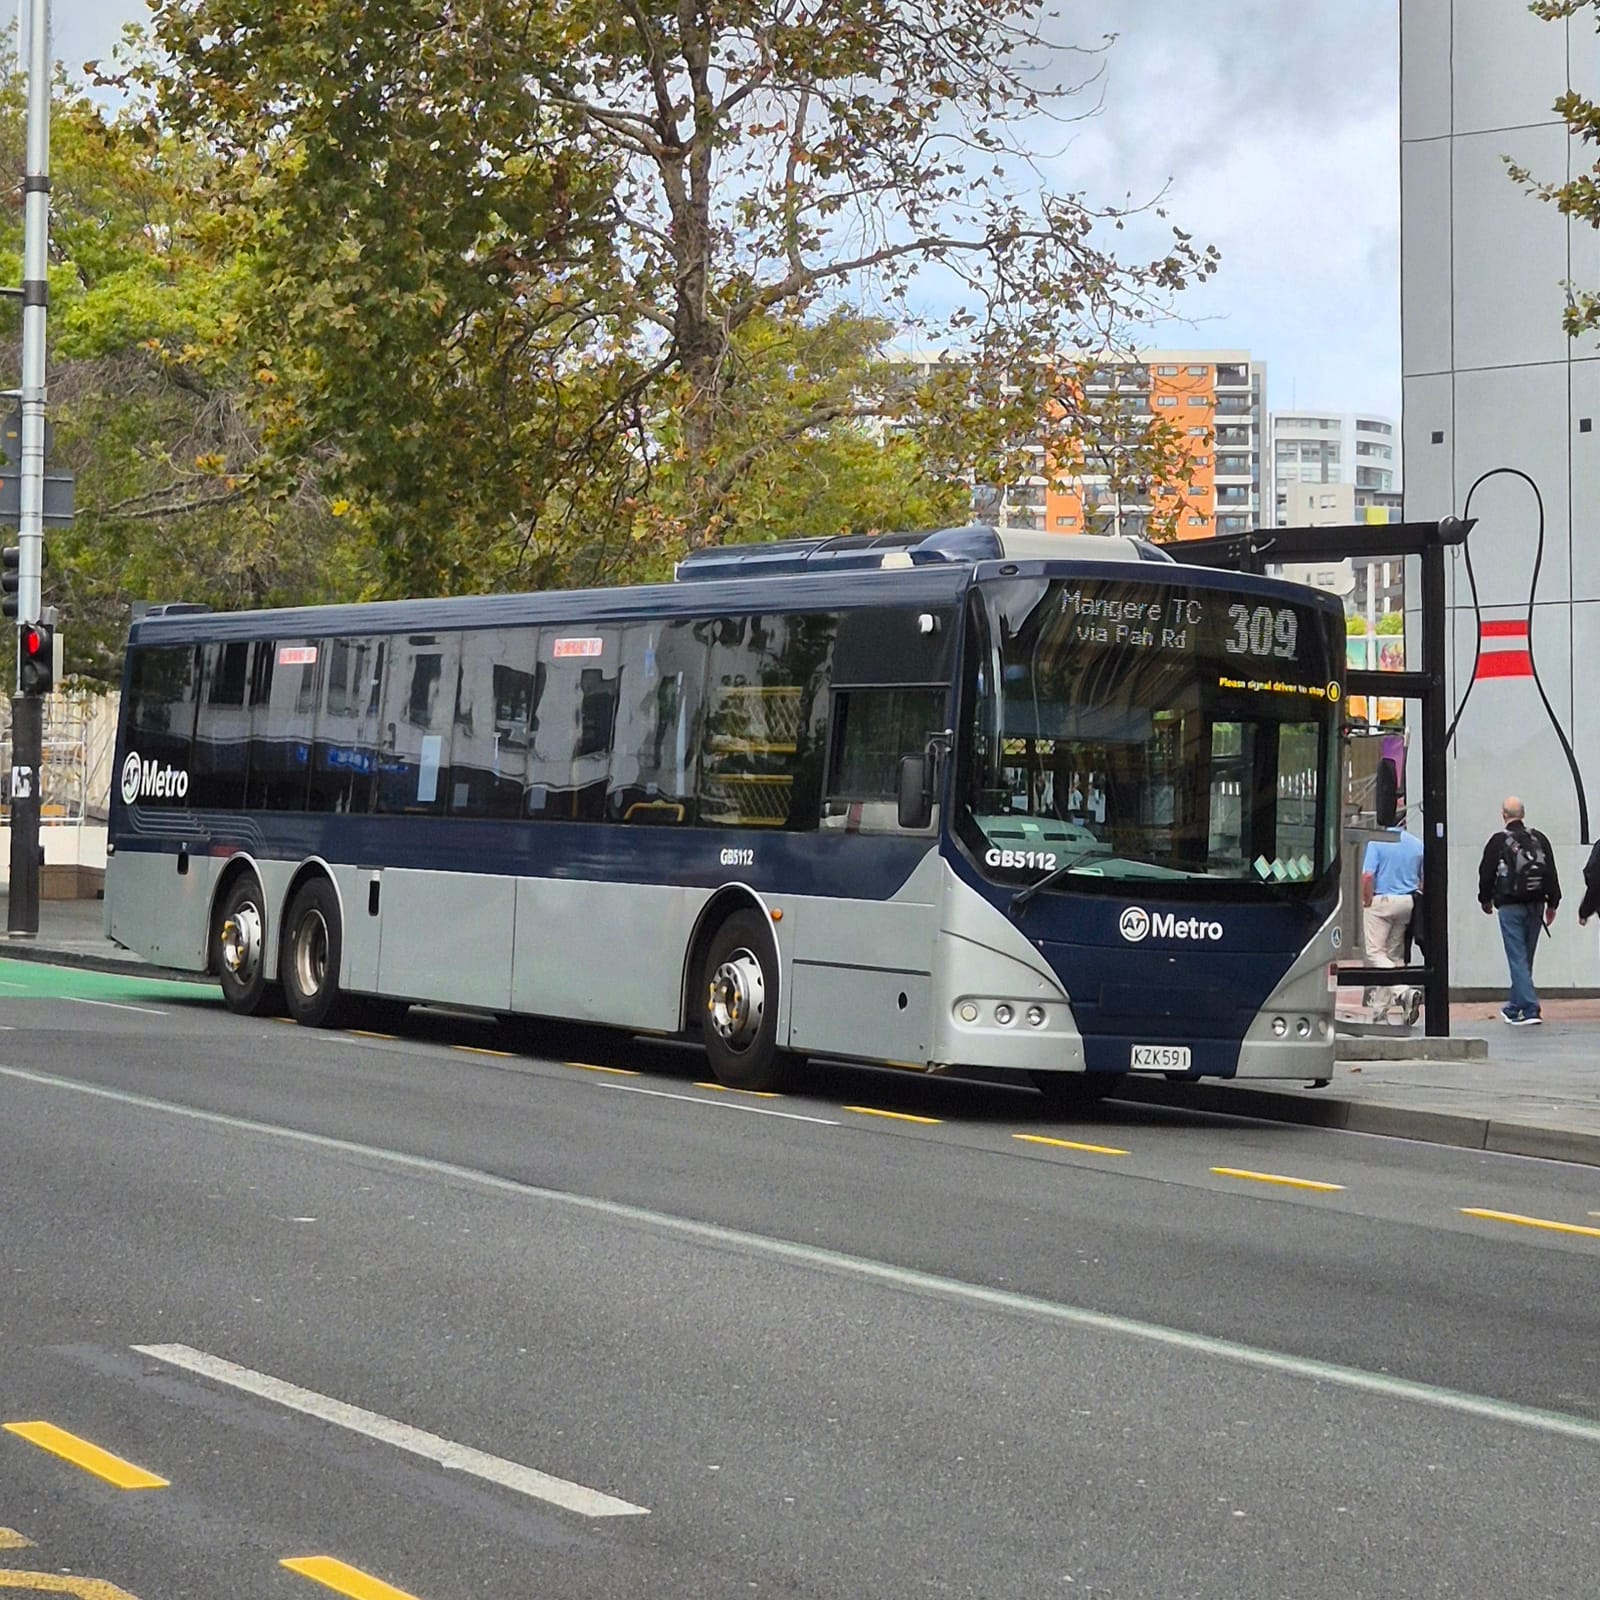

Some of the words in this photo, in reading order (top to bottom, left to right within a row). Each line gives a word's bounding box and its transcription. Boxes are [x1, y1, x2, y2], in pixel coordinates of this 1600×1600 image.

[1061, 588, 1162, 623] Mangere
[1172, 599, 1203, 625] TC
[1077, 625, 1108, 643] via
[1115, 625, 1154, 646] Pah
[1161, 628, 1186, 650] Rd
[1225, 604, 1298, 659] 309
[1219, 677, 1246, 688] Please
[1247, 680, 1272, 691] signal
[1273, 682, 1297, 692] driver
[1298, 685, 1307, 693] to
[1308, 686, 1326, 697] stop
[140, 759, 189, 798] Metro
[720, 848, 754, 866] GB5112
[985, 848, 1057, 871] GB5112
[1151, 912, 1223, 940] Metro
[1134, 1048, 1187, 1067] KZK591
